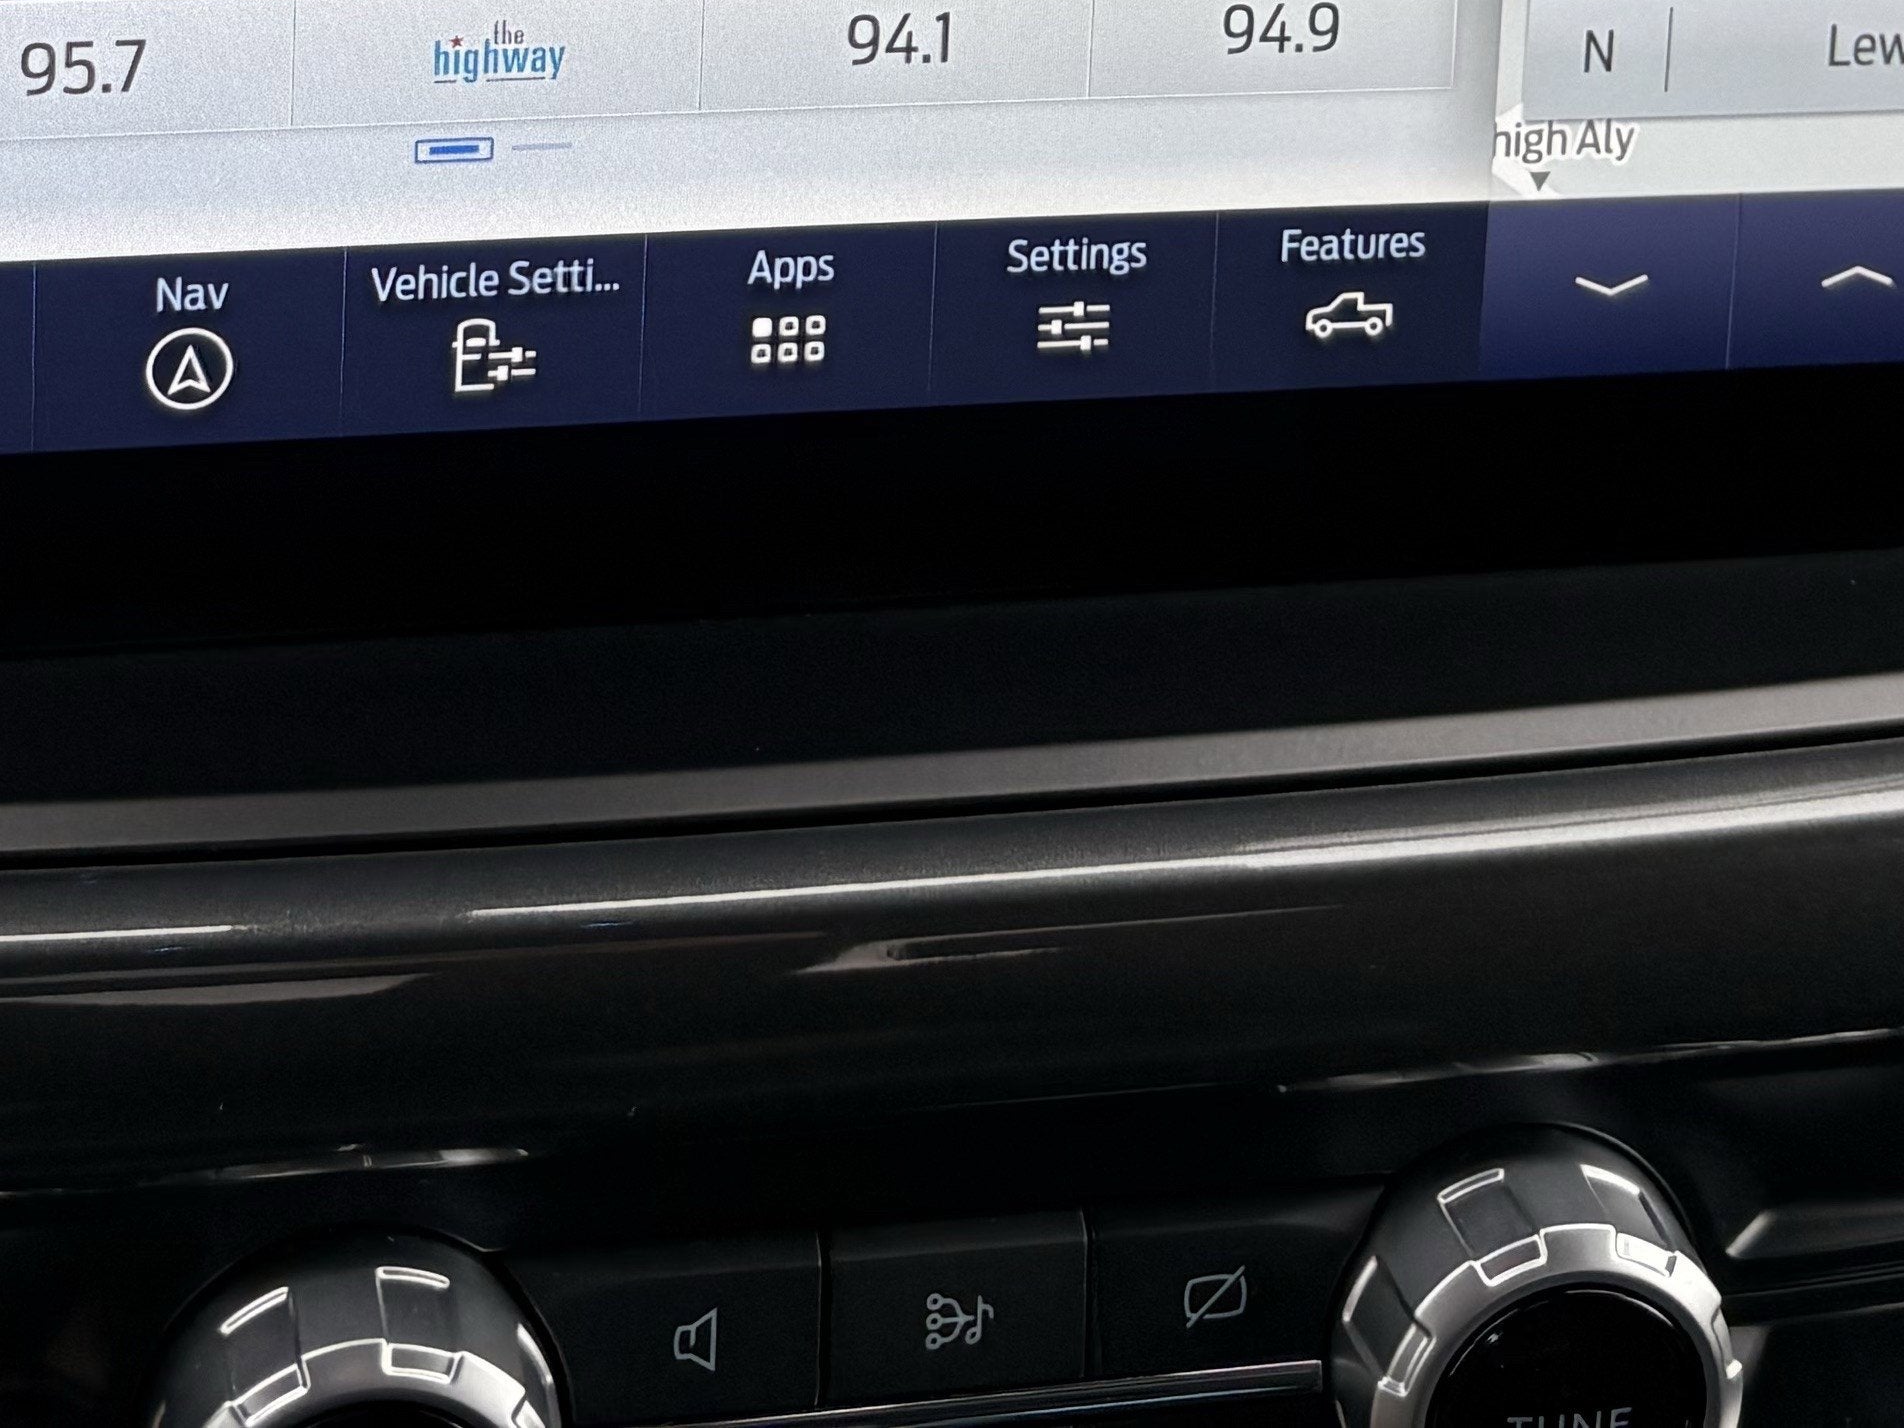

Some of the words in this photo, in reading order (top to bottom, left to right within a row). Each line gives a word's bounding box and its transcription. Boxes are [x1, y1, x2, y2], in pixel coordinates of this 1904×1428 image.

[493, 19, 524, 44] the
[847, 11, 954, 67] 94.1
[1223, 1, 1341, 55] 94.9
[20, 38, 148, 97] 95.7
[434, 38, 565, 83] highway
[1583, 29, 1616, 74] N
[1576, 118, 1634, 161] Aly
[1007, 237, 1149, 278] Settings
[1281, 227, 1427, 265] Features
[371, 261, 500, 302] Vehicle
[507, 257, 620, 296] Setti...
[747, 249, 836, 292] Apps
[156, 275, 230, 313] Nav
